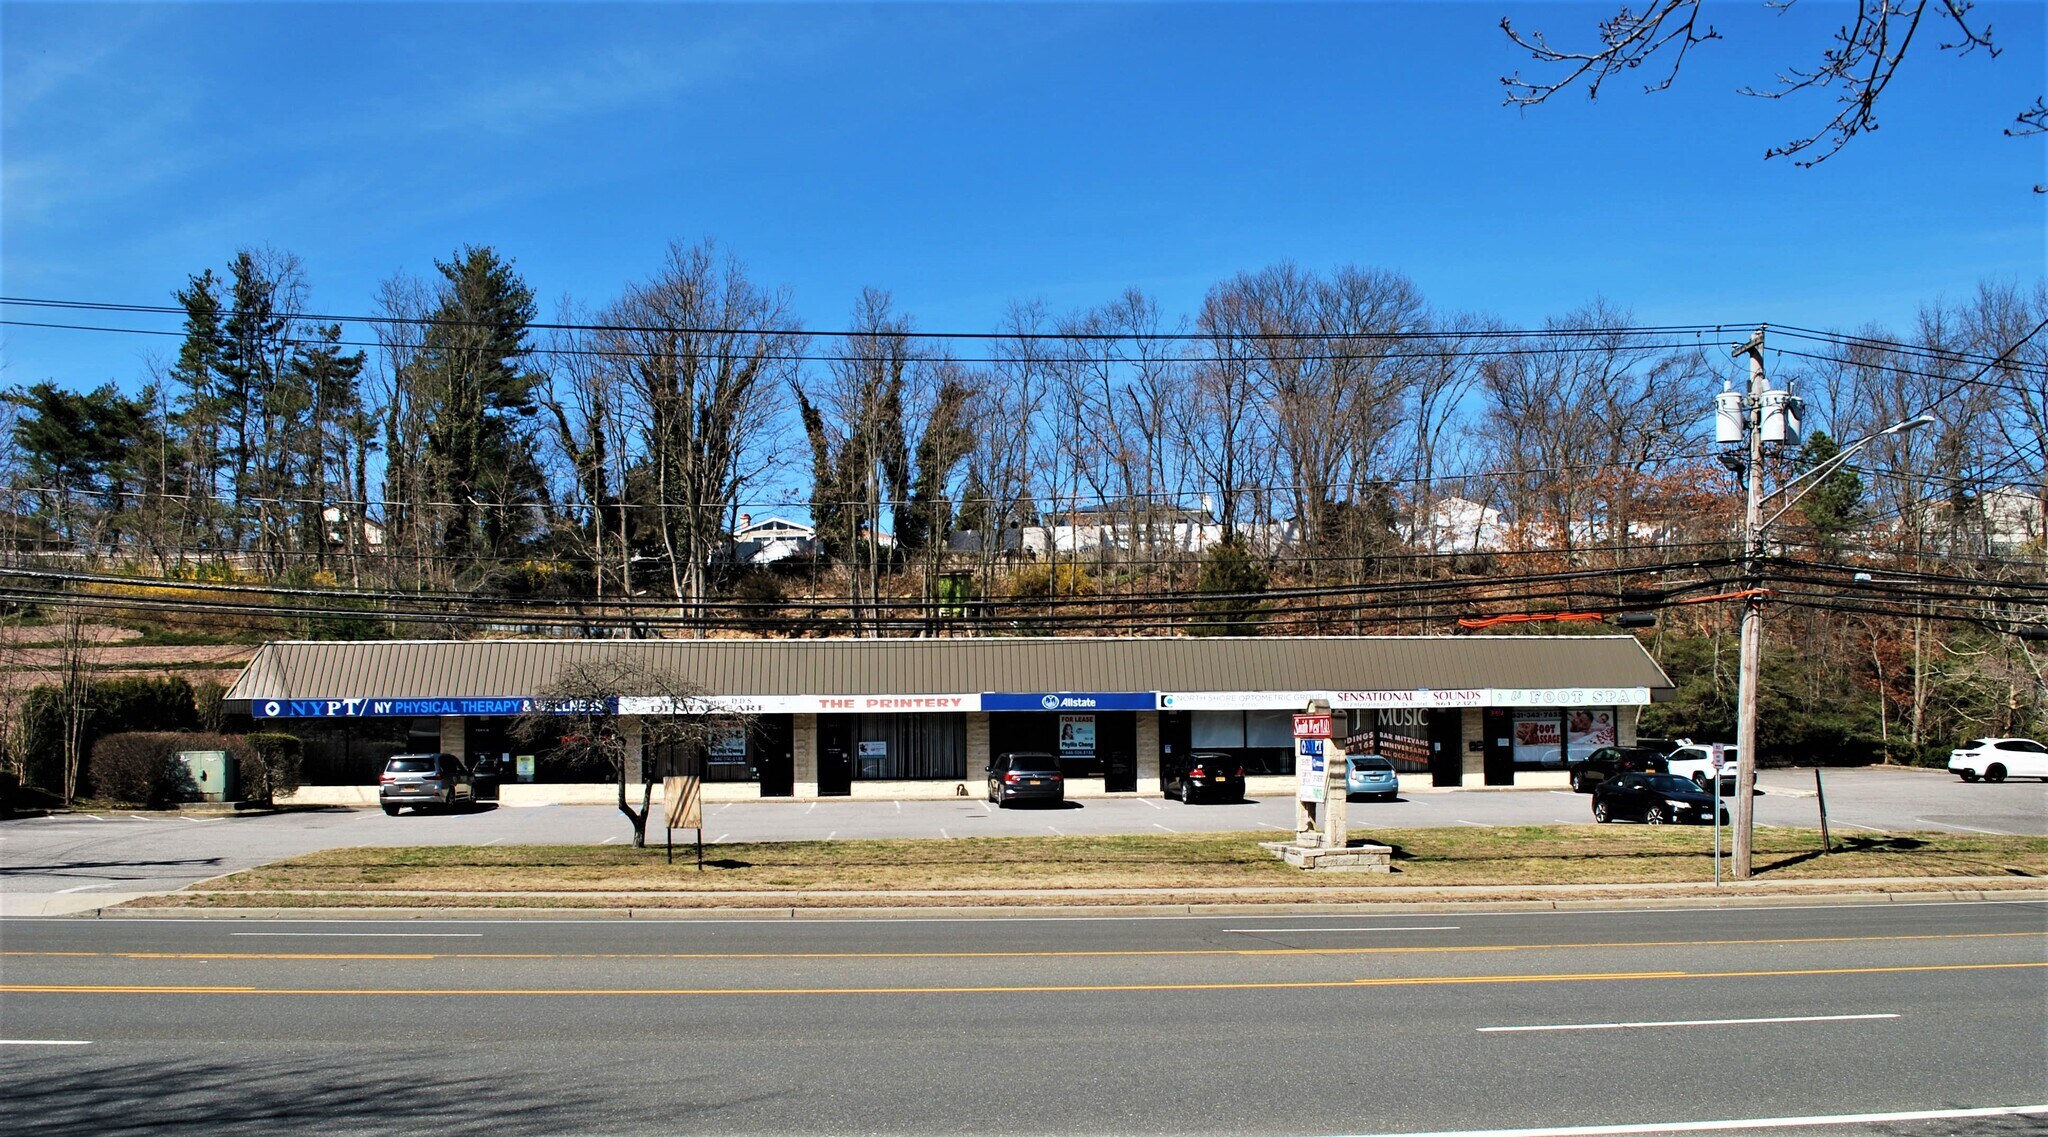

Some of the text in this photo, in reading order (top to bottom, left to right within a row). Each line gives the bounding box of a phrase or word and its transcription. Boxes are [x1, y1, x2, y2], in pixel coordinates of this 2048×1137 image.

[1337, 691, 1481, 701] SENSATIONAL SOUNDS
[1530, 691, 1583, 703] FOOT
[1592, 690, 1630, 703] SPA
[374, 702, 392, 714] NY
[395, 700, 458, 714] PHYSICAL
[460, 700, 520, 712] THERAPY
[522, 699, 532, 712] &
[818, 698, 962, 708] THE PRINTERY
[1060, 698, 1096, 707] Allstate
[1378, 708, 1429, 726] MUSIC
[1380, 732, 1429, 747] BAR MITZVAHS
[1534, 734, 1561, 743] ASSAGE
[1393, 752, 1428, 764] OCCASIONS
